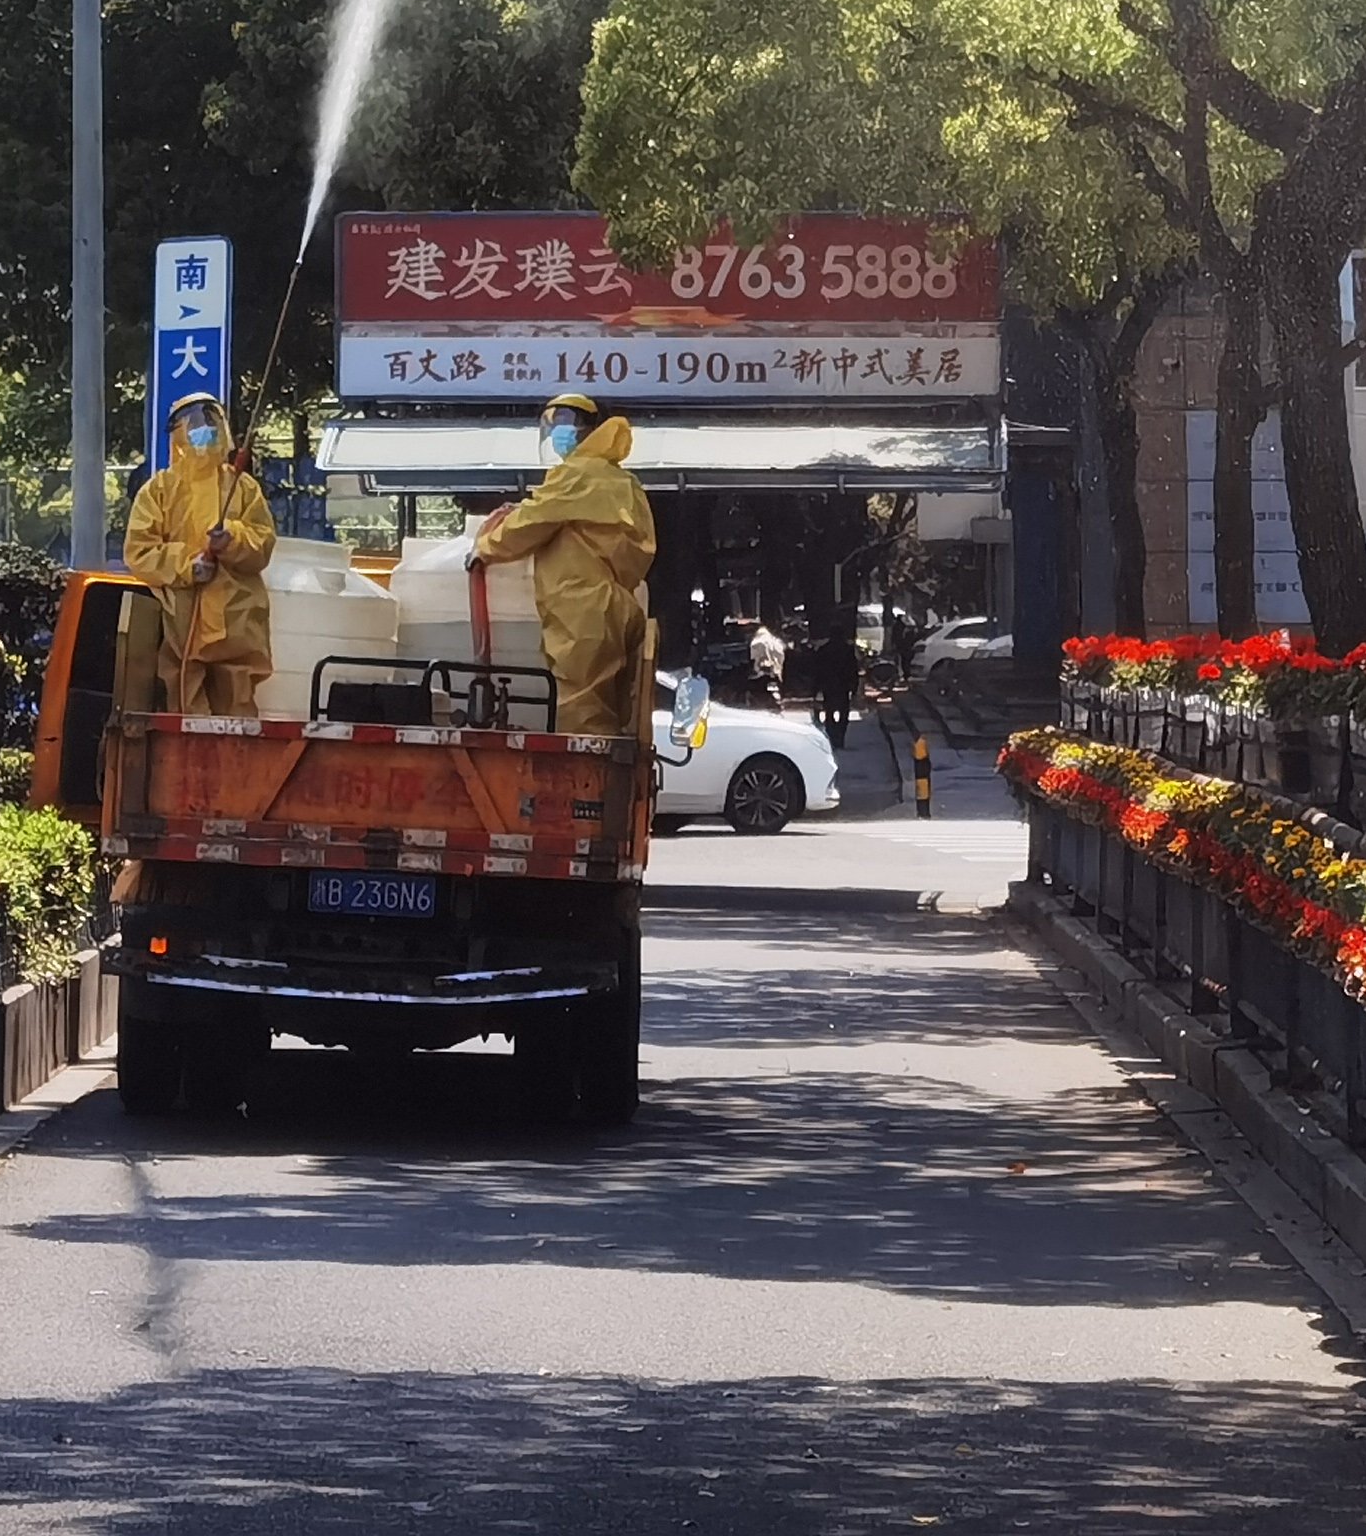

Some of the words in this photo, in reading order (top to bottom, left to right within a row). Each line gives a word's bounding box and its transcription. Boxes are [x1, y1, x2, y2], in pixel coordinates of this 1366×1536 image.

[175, 254, 209, 292] 南
[385, 238, 633, 301] 建发璞云
[671, 244, 807, 299] 8763
[820, 244, 958, 299] 5888
[171, 336, 208, 379] 大
[384, 349, 487, 384] 百丈路
